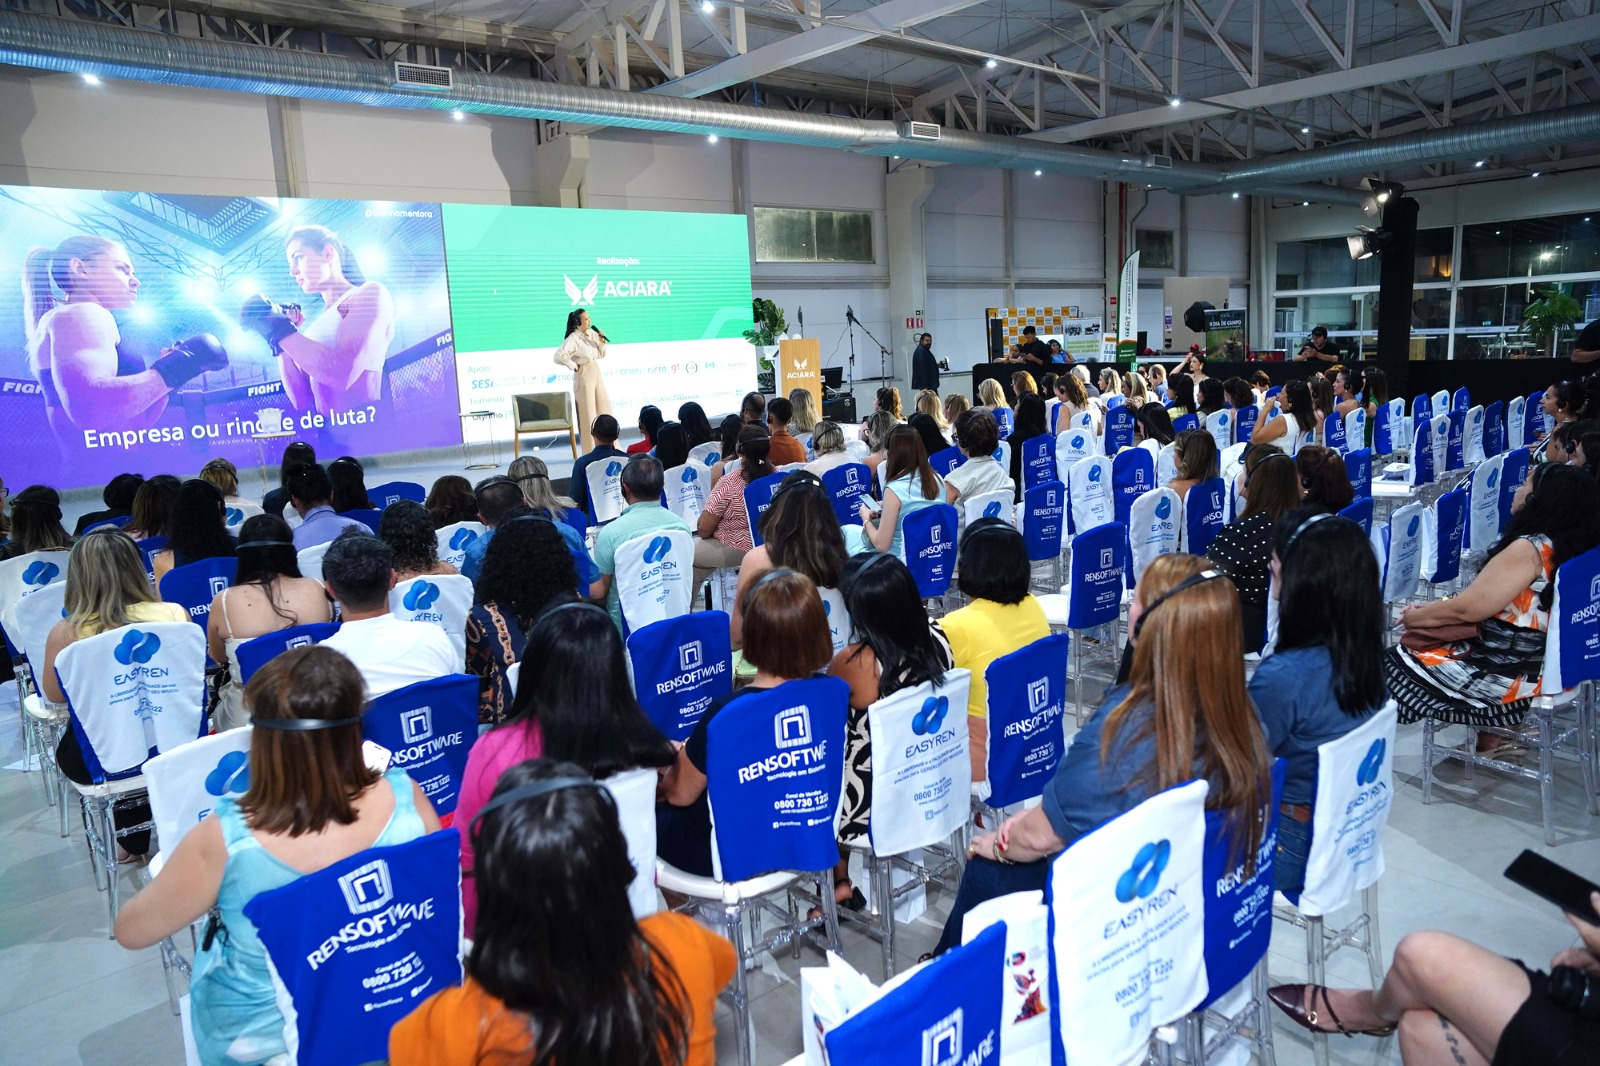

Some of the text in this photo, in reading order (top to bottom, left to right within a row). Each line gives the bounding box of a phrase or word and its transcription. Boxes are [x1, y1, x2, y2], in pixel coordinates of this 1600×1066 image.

[787, 371, 815, 379] ACIARA
[248, 382, 281, 397] FIGHT
[83, 425, 185, 450] Empresa
[190, 422, 220, 440] ou
[300, 410, 325, 430] de
[330, 406, 377, 426] luta?
[656, 660, 726, 695] RENSOFTWARE
[679, 705, 695, 715] 0800
[390, 731, 463, 765] NSOFTWARE
[906, 727, 956, 758] EASYREN
[914, 790, 932, 802] 0800
[774, 800, 795, 810] 0800
[796, 798, 813, 809] 730
